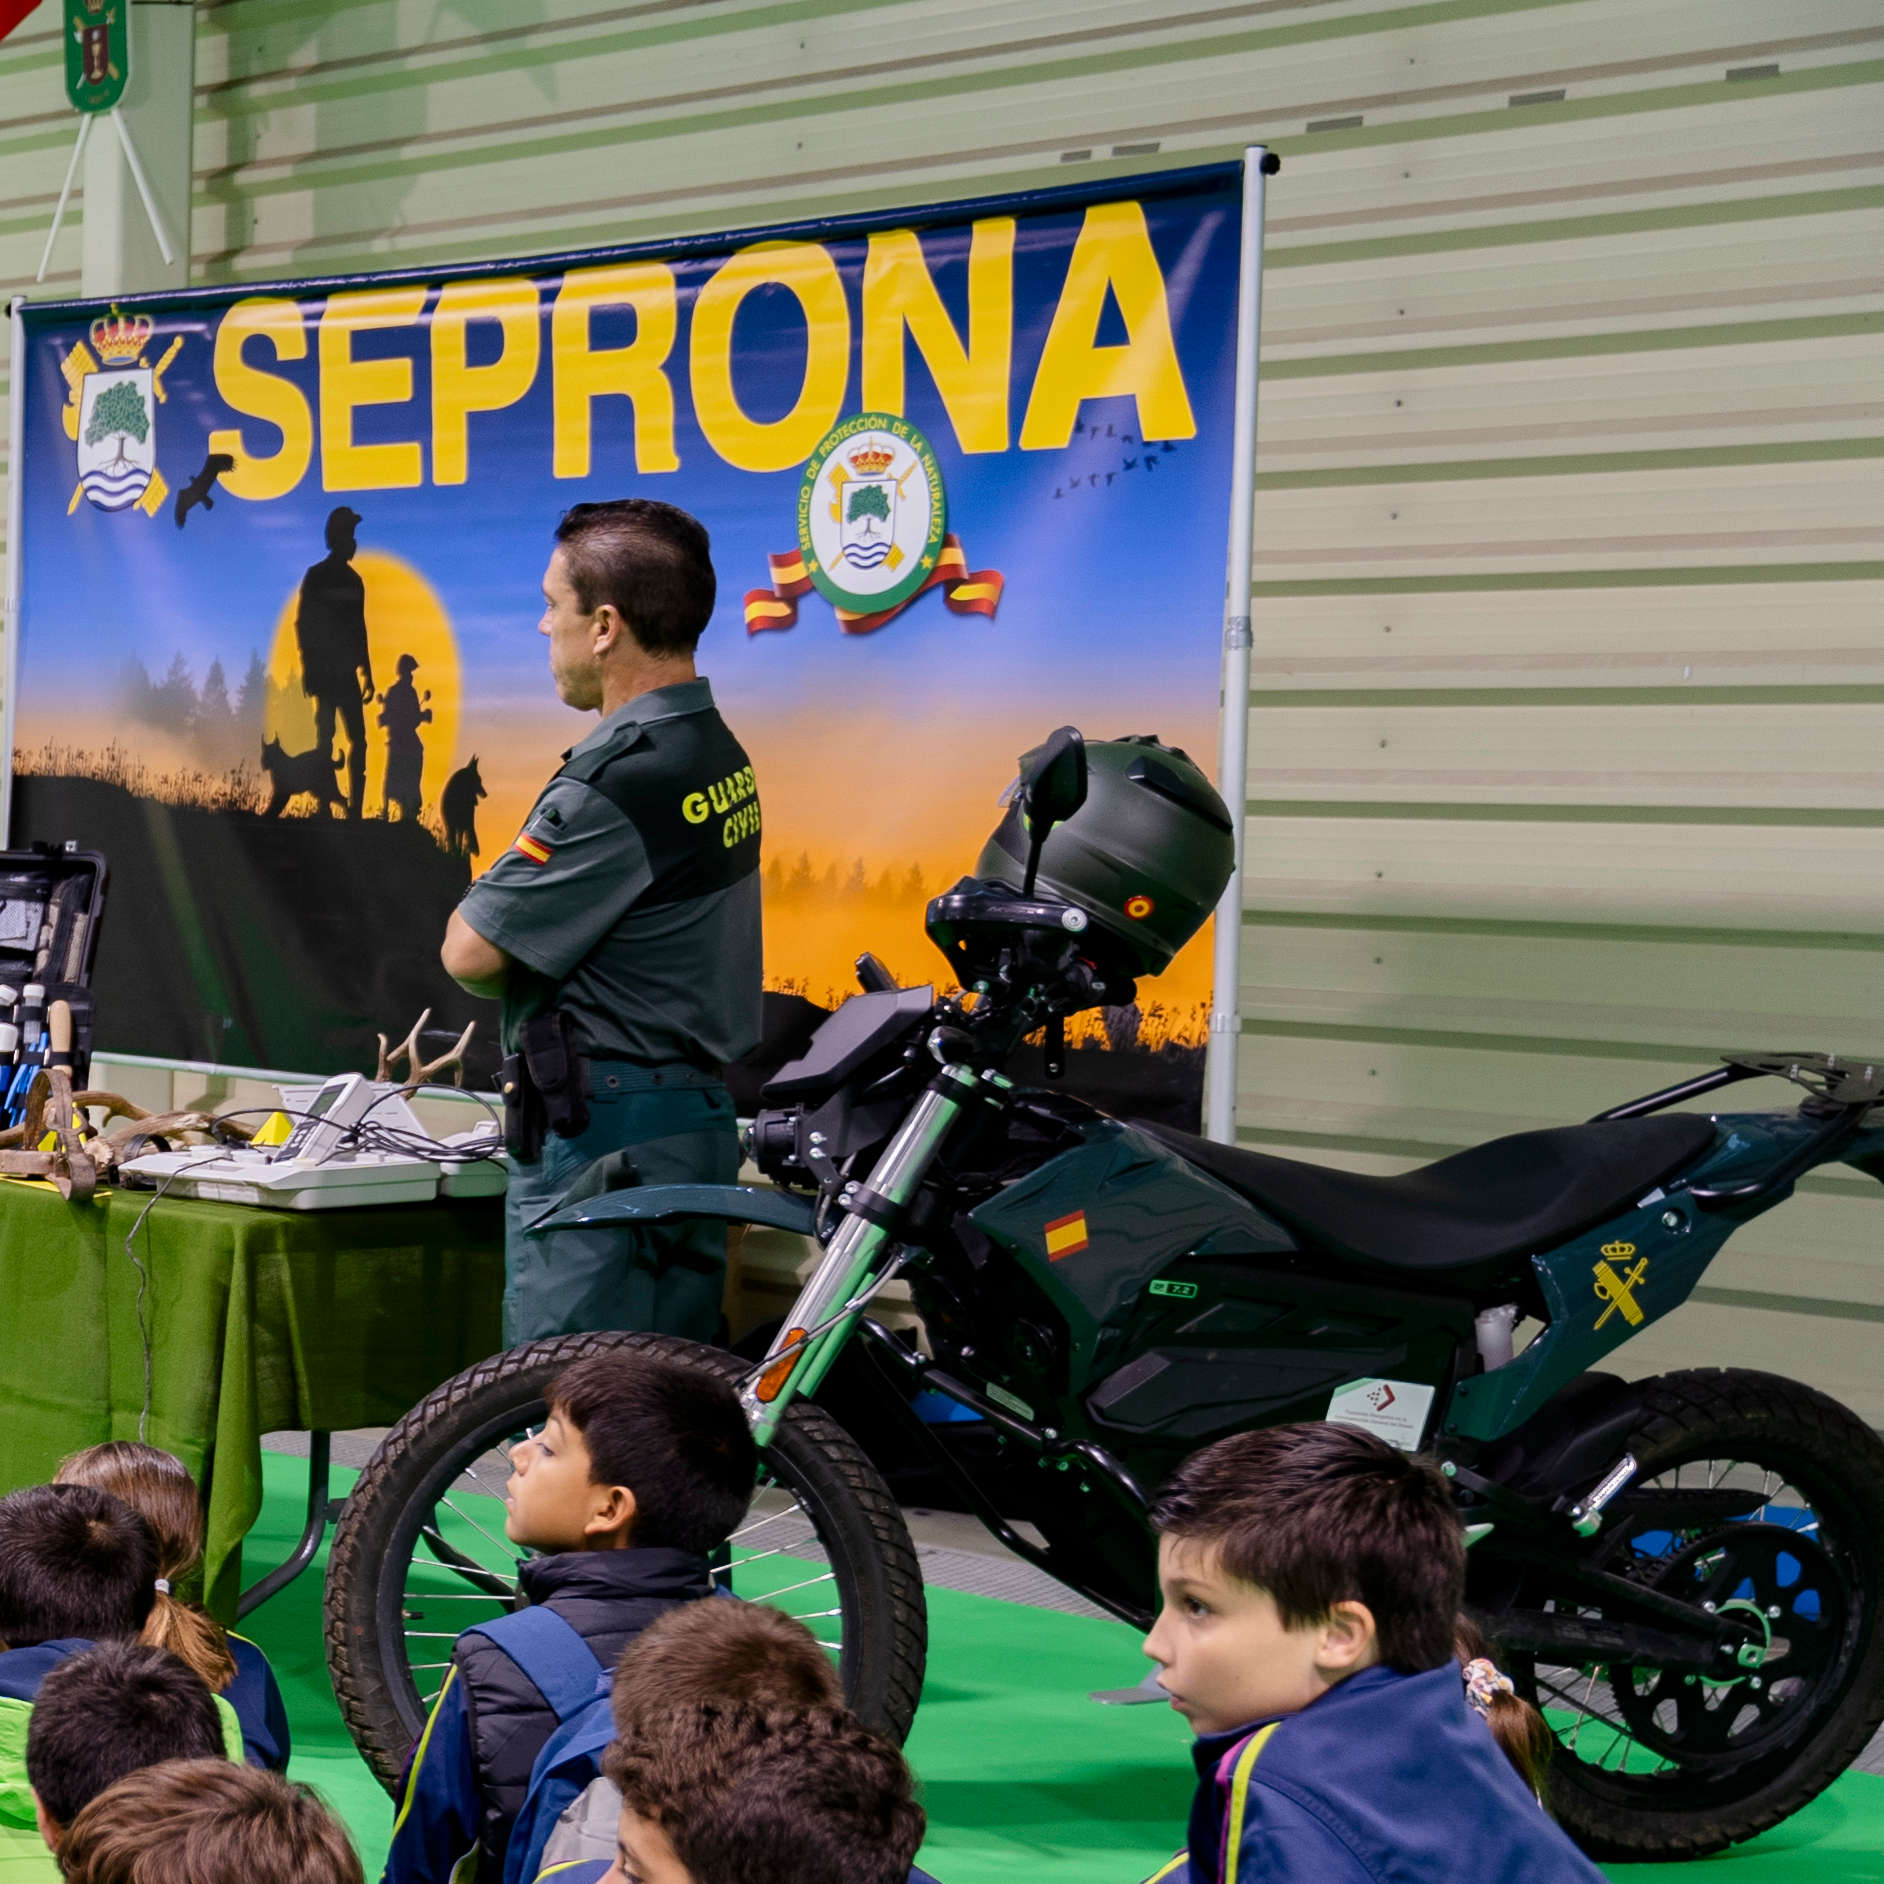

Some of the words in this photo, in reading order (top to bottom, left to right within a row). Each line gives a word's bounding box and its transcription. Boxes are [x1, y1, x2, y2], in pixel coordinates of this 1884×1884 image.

[208, 201, 1198, 500] SEPRONA
[797, 486, 811, 551] SERVICIO
[806, 460, 821, 480] DE
[819, 415, 888, 457] PROTECCIÓN
[891, 421, 909, 436] DE
[910, 433, 924, 453] LA
[921, 454, 943, 544] NATURALEZA
